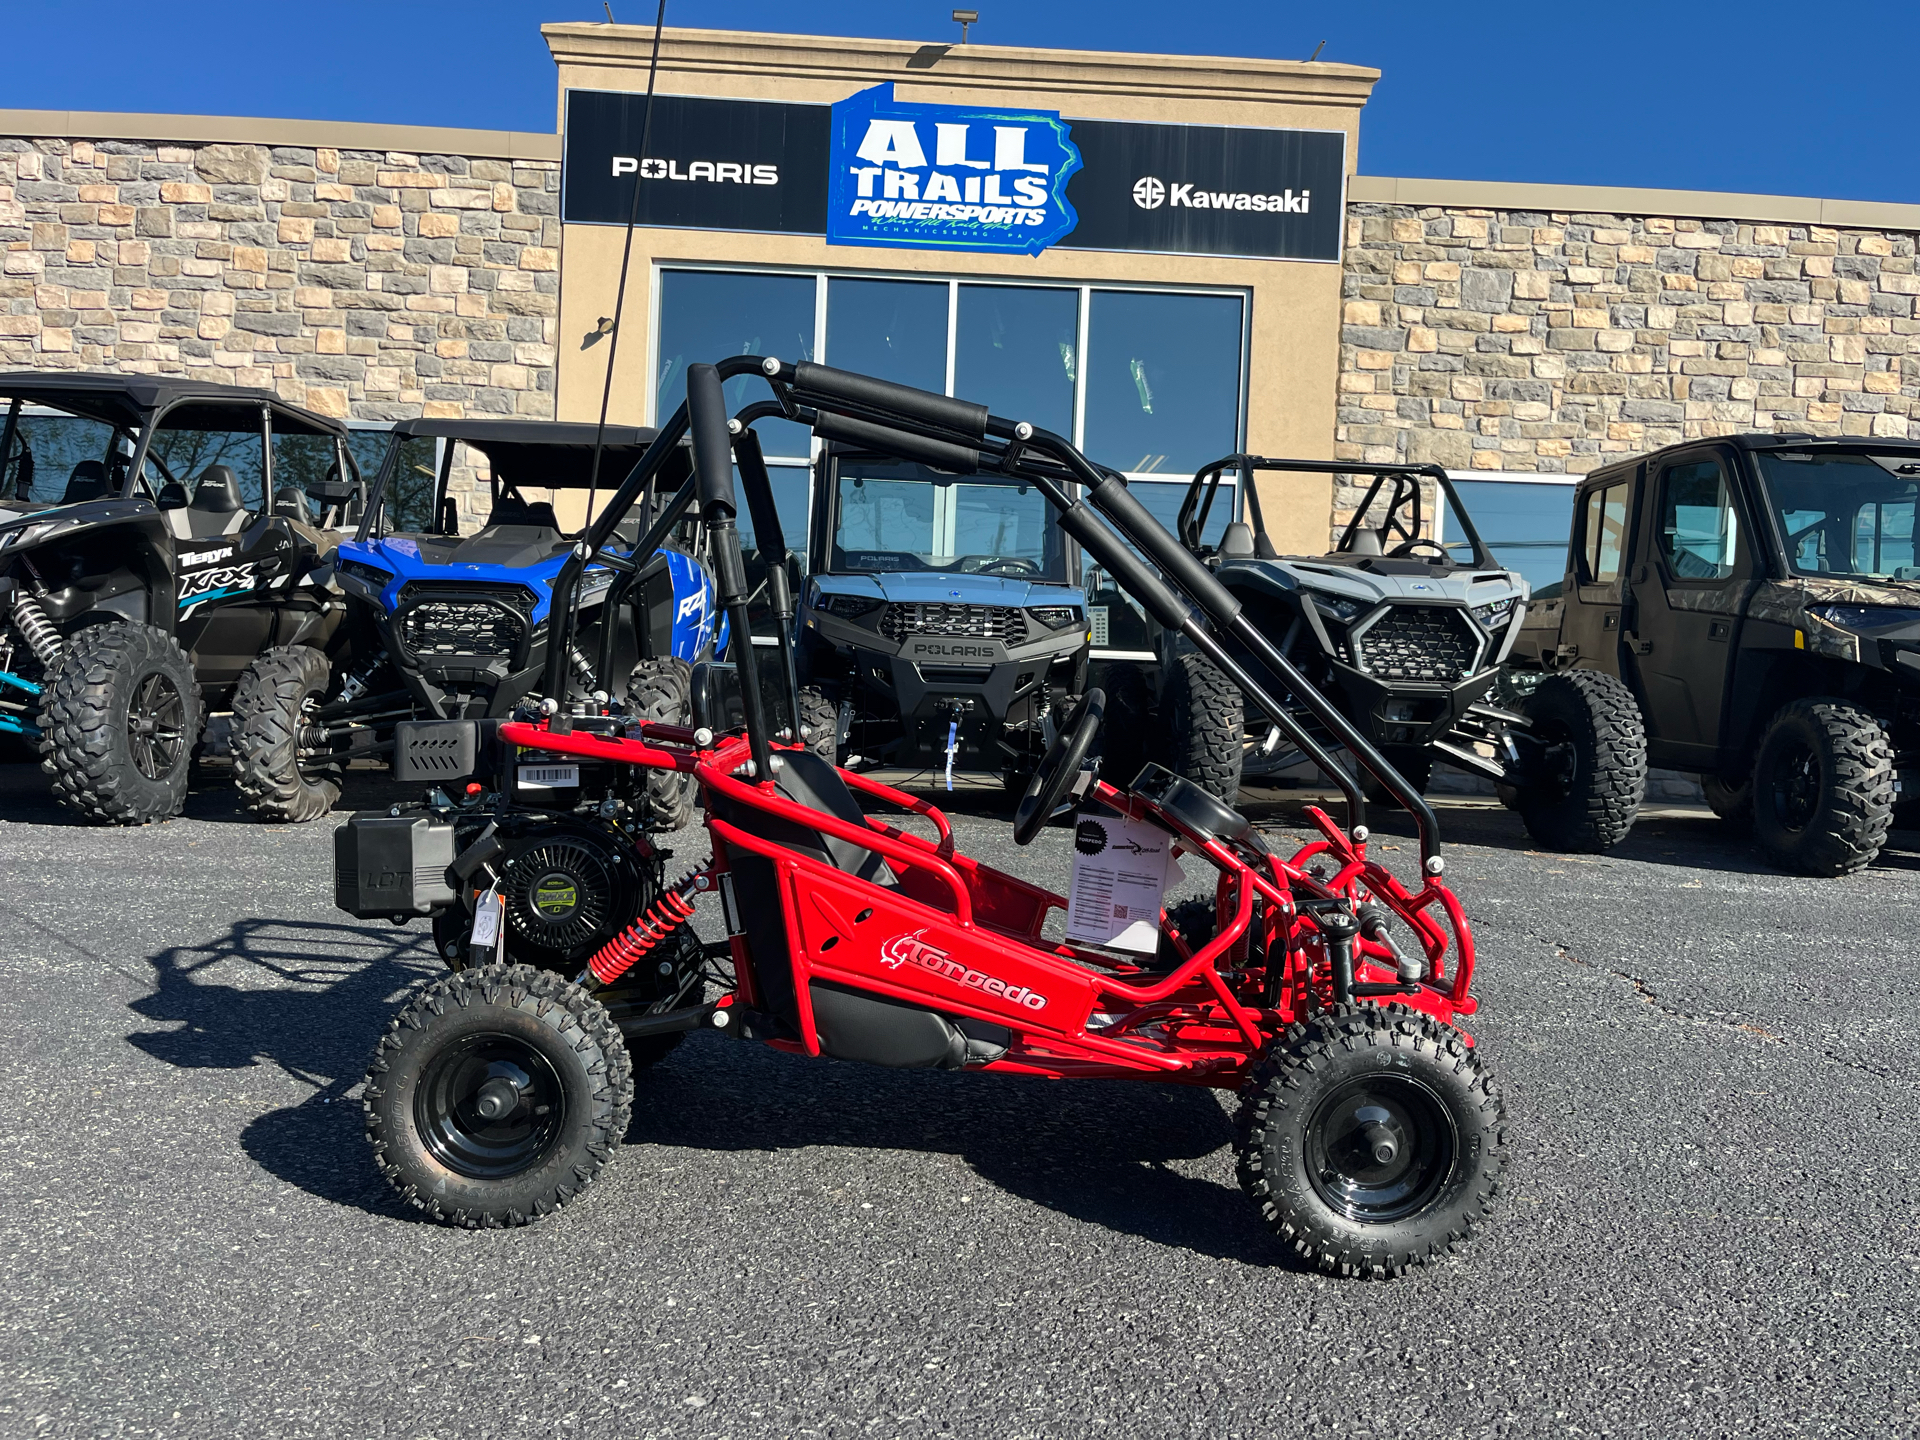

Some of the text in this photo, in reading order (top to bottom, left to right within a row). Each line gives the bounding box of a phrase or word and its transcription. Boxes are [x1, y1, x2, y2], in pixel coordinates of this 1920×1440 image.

[855, 119, 1049, 176] ALL
[612, 156, 779, 185] POLARIS
[850, 166, 1048, 207] TRAILS
[1170, 183, 1310, 214] Kawasaki
[850, 199, 1047, 226] POWERSPORTS
[914, 644, 995, 657] POLARIS
[903, 938, 1048, 1010] Torpedo
